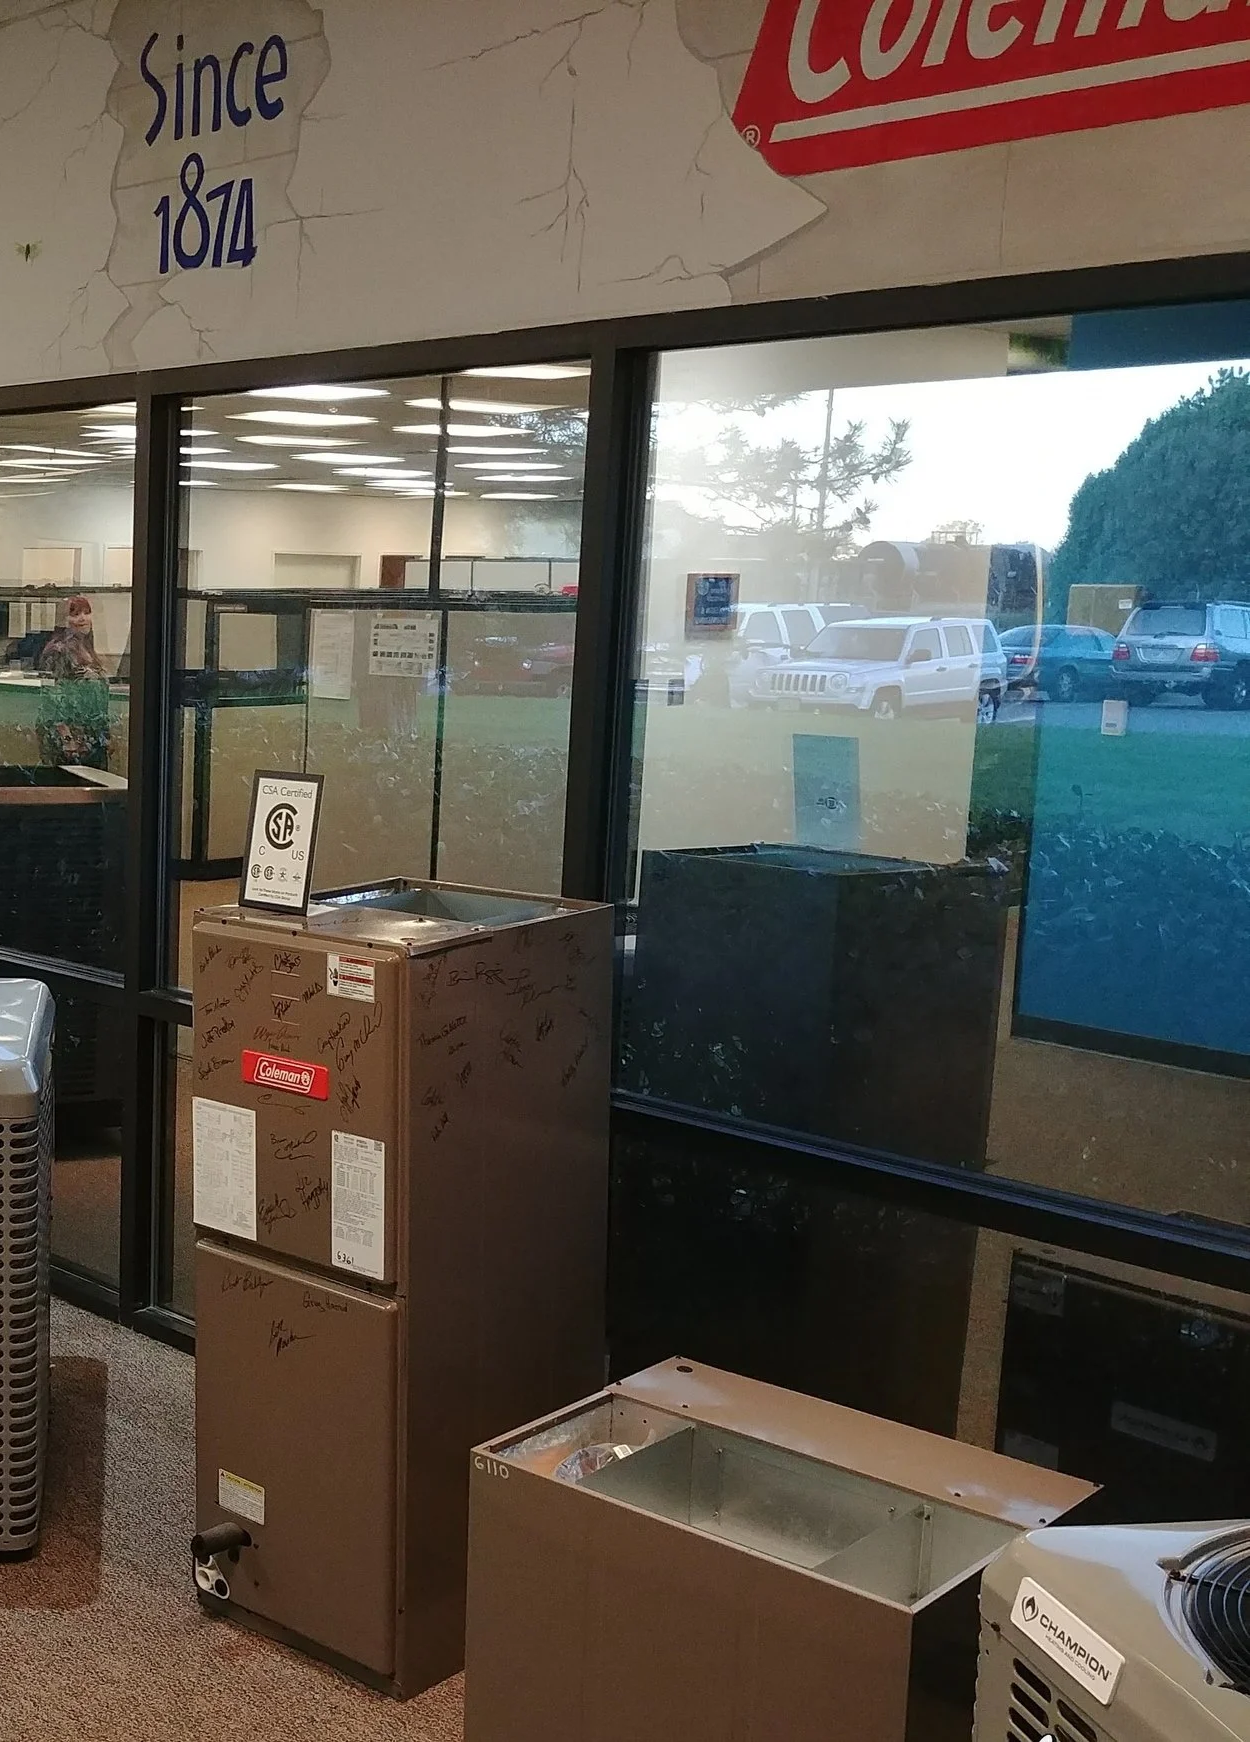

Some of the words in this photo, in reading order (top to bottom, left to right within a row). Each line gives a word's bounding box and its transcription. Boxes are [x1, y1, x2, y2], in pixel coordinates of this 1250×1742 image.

[141, 32, 288, 147] Since
[154, 153, 258, 274] 1874
[262, 784, 279, 796] CSA
[280, 786, 313, 799] Certified
[265, 803, 299, 850] CSA
[258, 846, 266, 856] C
[291, 849, 305, 861] US
[259, 1061, 301, 1084] Coleman
[474, 1456, 510, 1479] 6110
[1045, 1634, 1065, 1654] HEATING
[1064, 1652, 1075, 1663] AND
[1074, 1661, 1096, 1681] COOLING
